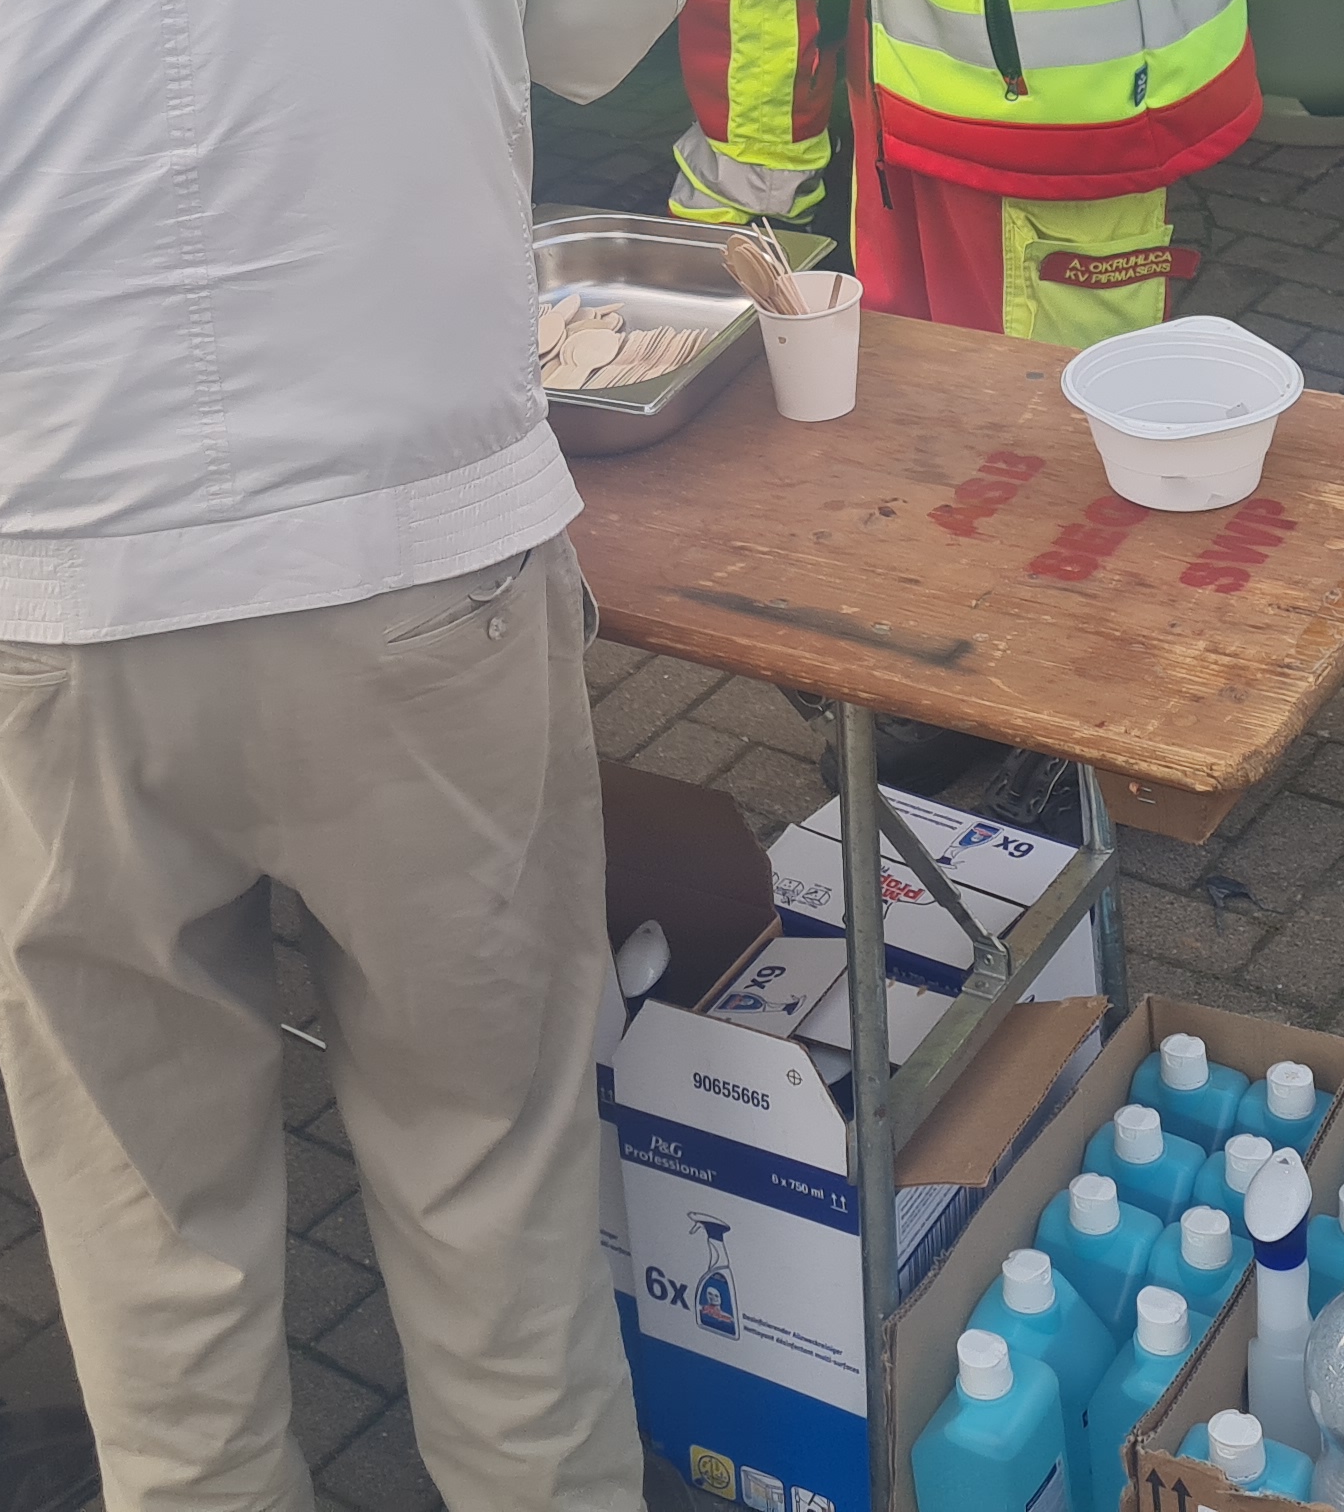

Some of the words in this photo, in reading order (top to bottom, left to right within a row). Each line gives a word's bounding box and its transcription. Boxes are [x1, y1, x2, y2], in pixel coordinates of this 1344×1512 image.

[1064, 269, 1089, 283] KV
[1090, 262, 1171, 284] PIRMASENS
[1089, 251, 1173, 273] OKRUHLICA
[926, 450, 1048, 540] ASB
[1179, 497, 1299, 594] SWP
[993, 835, 1034, 859] 6x
[743, 965, 787, 990] 6x
[692, 1072, 770, 1110] 90655665
[650, 1134, 683, 1159] P&G
[771, 1174, 779, 1184] 6
[790, 1179, 809, 1195] 750
[810, 1186, 825, 1200] ml
[645, 1265, 691, 1311] 6x
